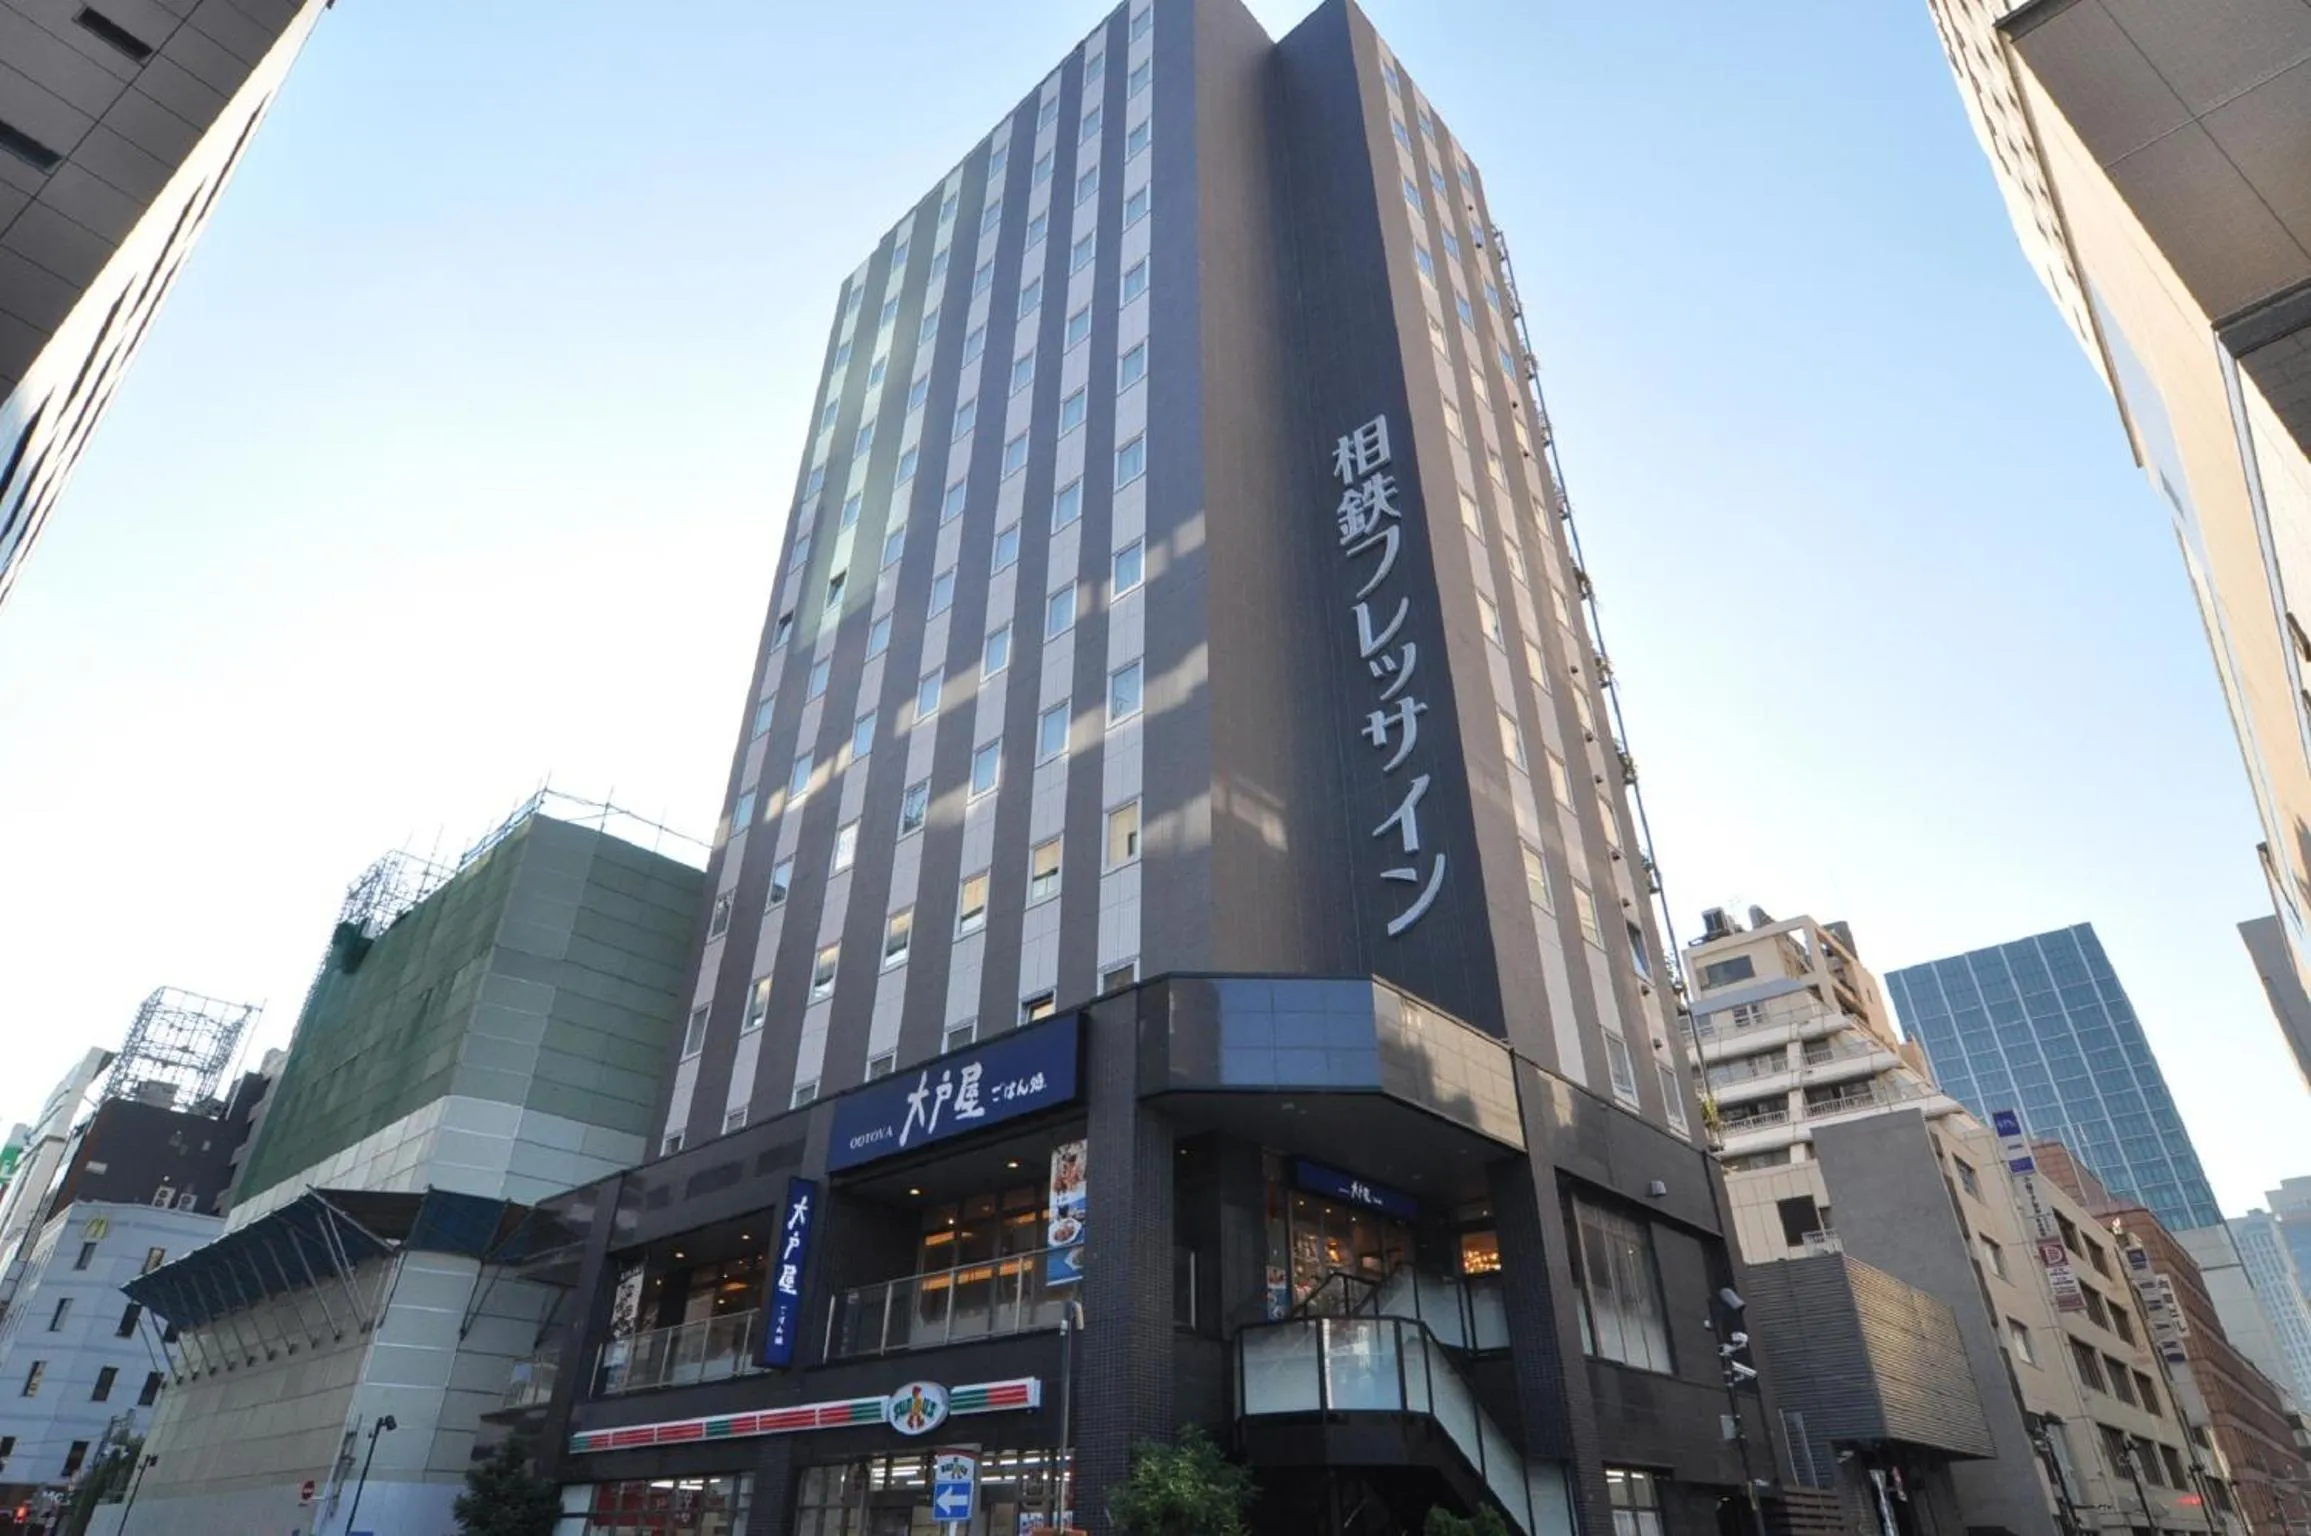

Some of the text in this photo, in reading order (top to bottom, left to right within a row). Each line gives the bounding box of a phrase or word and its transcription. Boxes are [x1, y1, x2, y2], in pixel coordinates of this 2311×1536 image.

[1332, 413, 1446, 938] 相鉄フレッサイン
[849, 1126, 894, 1150] OOTOYA
[899, 1061, 986, 1148] 大戸屋
[778, 1195, 809, 1296] 大戸屋
